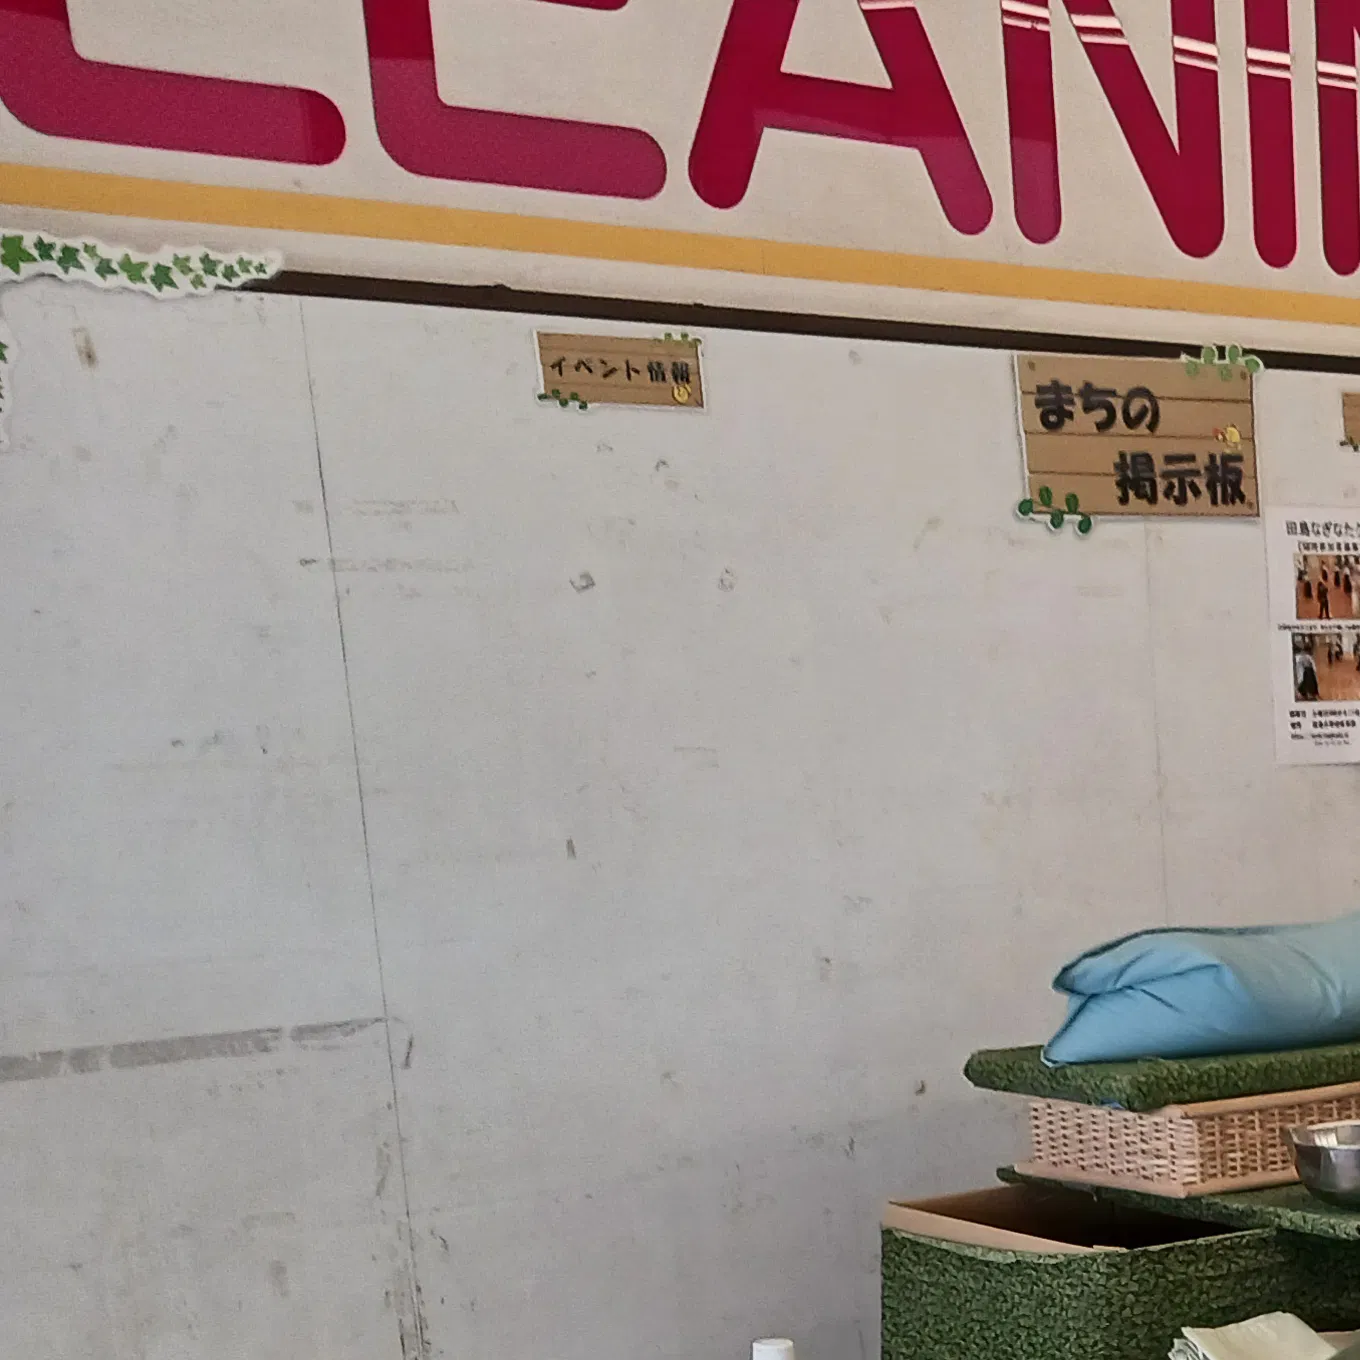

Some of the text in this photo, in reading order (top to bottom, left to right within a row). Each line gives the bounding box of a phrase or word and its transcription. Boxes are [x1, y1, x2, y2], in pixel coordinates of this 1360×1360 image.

[1035, 378, 1160, 433] まちの
[1113, 450, 1247, 506] 掲示板
